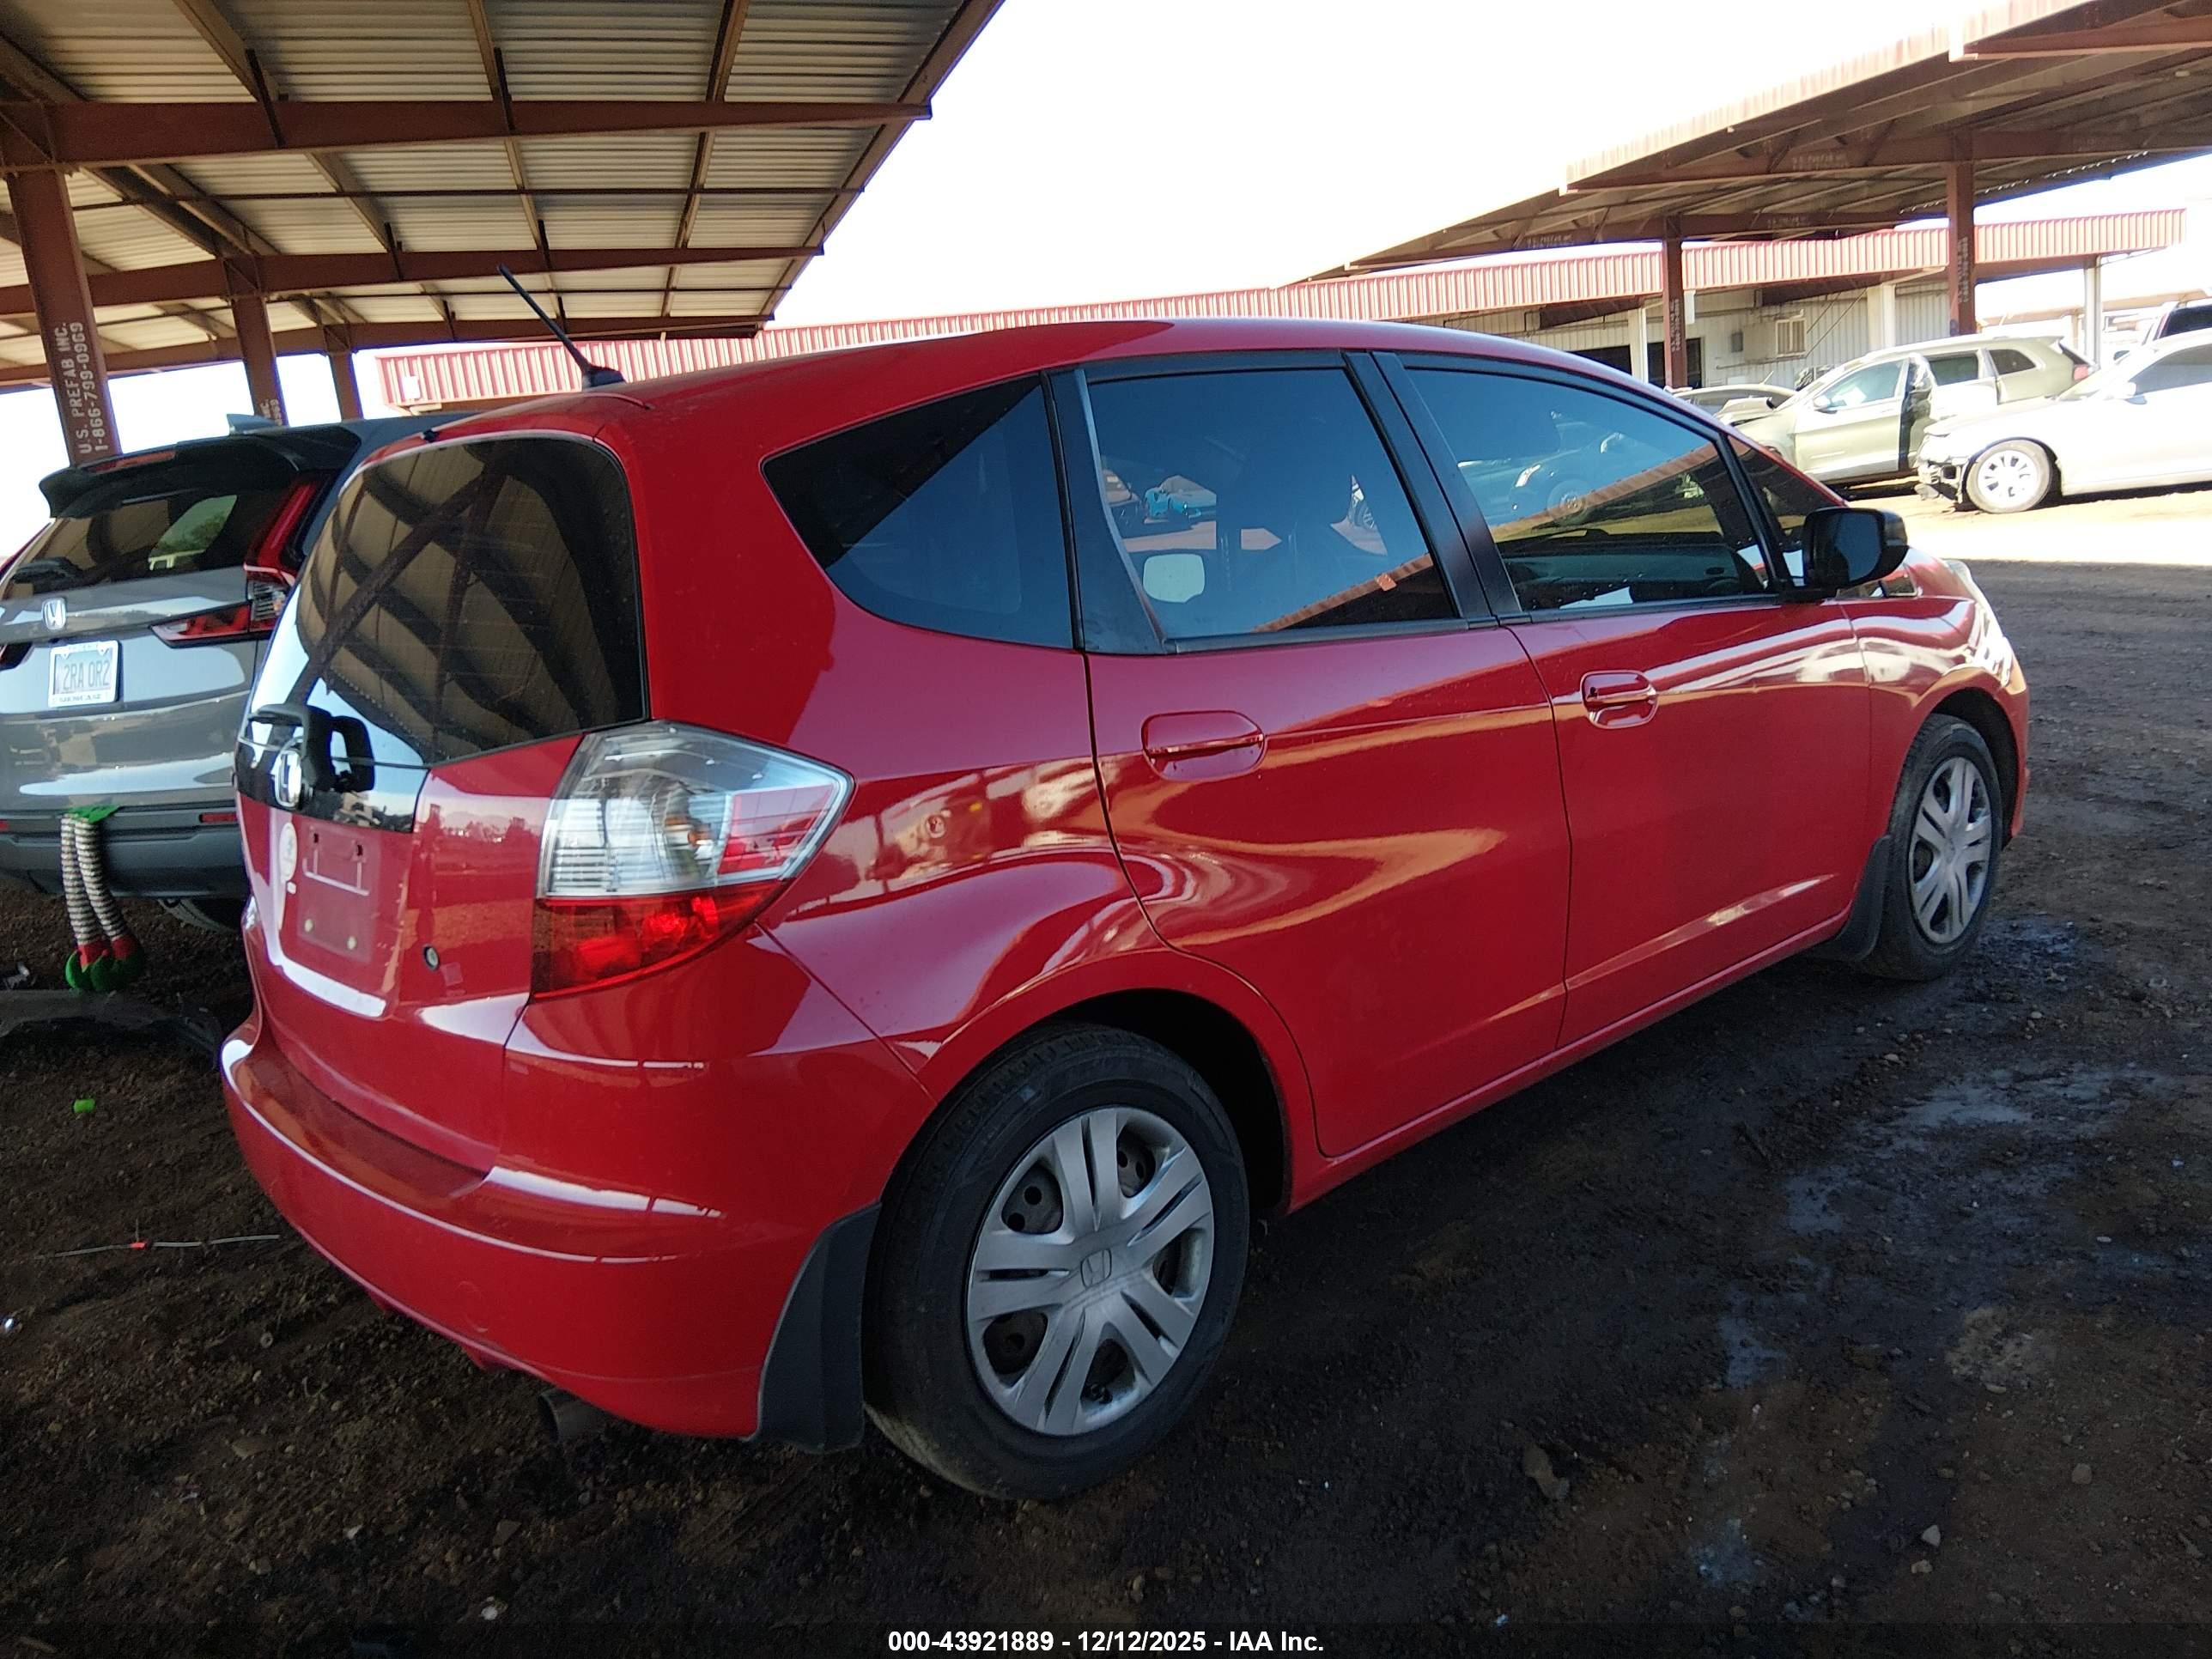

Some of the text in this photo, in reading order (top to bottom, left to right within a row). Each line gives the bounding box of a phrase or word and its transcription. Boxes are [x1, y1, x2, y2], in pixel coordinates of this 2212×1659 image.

[54, 322, 92, 453] U.S. PREFAB INC.
[70, 321, 108, 452] 1-866-799-0969
